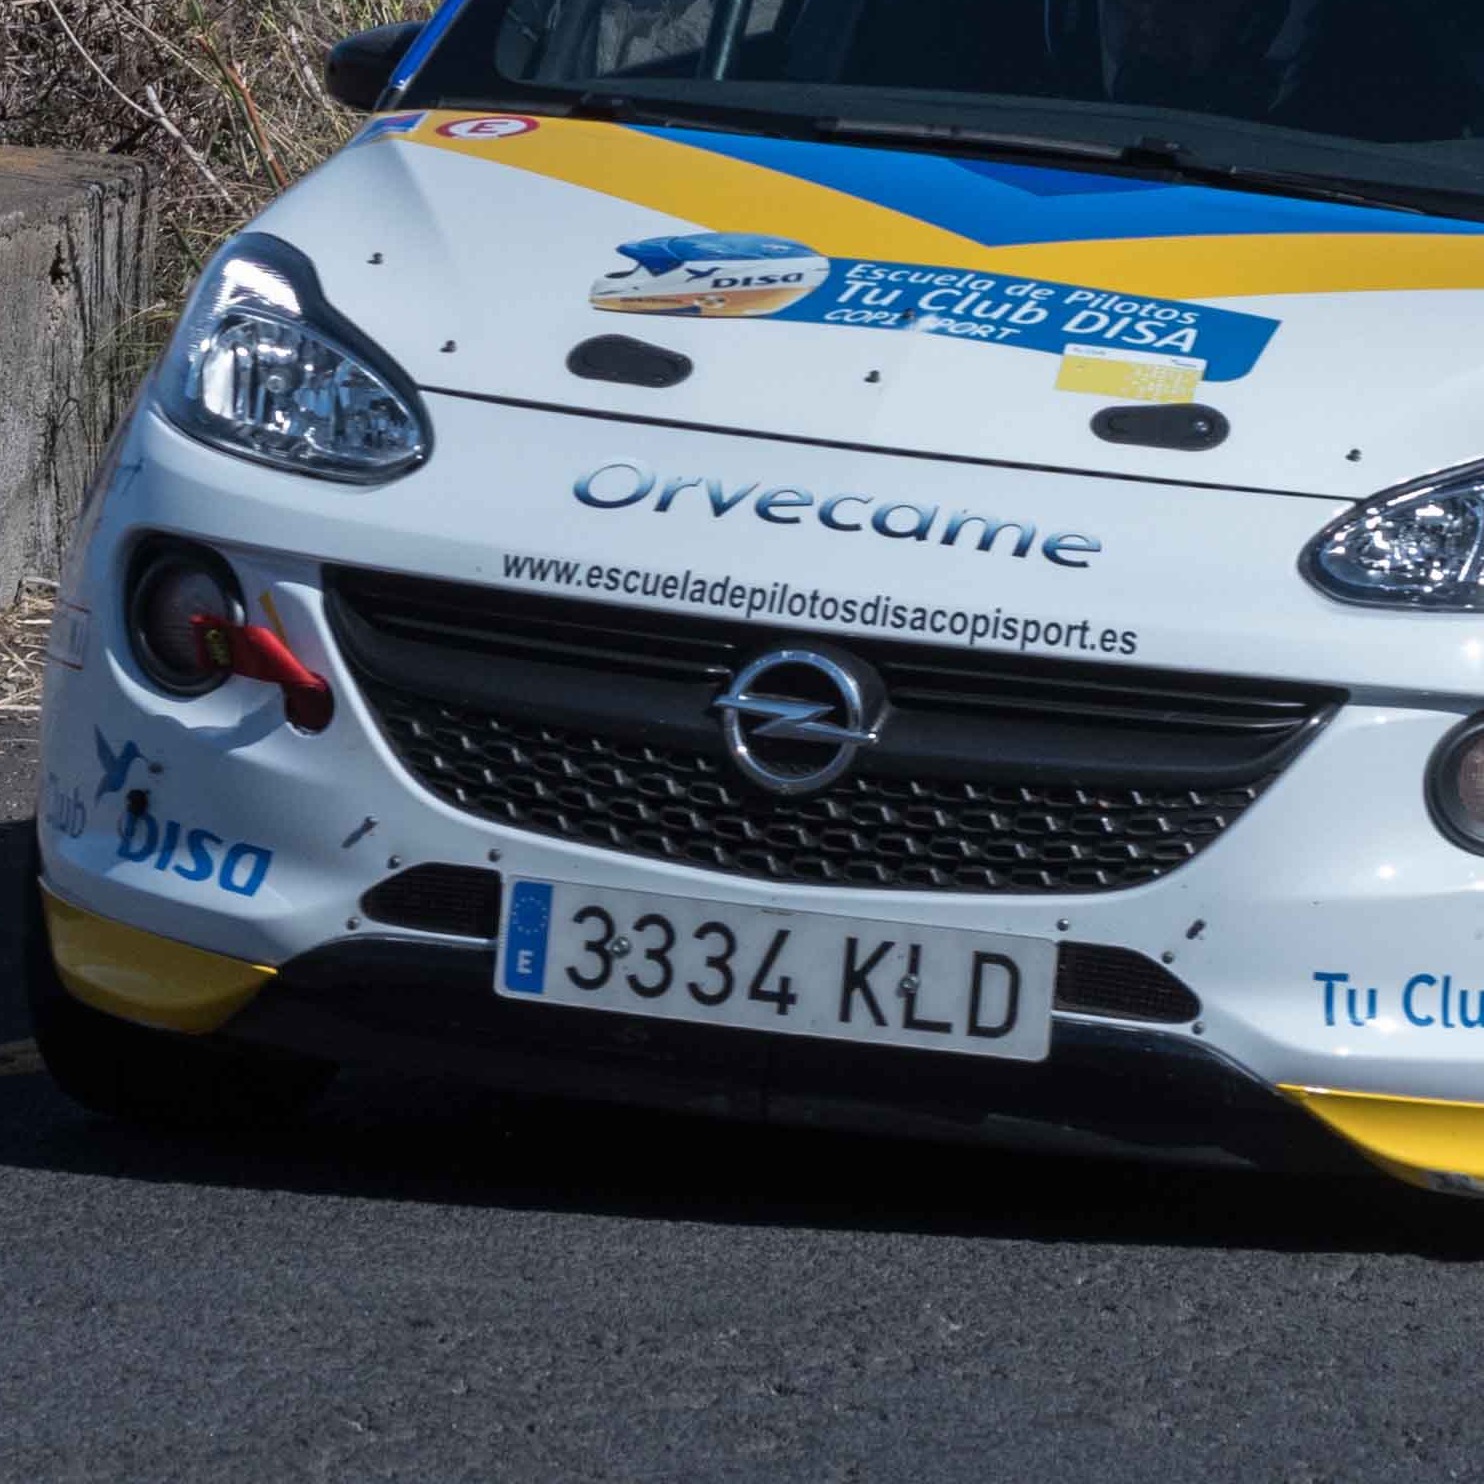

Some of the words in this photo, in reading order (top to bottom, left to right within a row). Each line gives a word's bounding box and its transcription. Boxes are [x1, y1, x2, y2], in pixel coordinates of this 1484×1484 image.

[823, 307, 904, 327] COPI
[835, 279, 904, 306] Tu
[917, 287, 1050, 326] Club
[1062, 309, 1200, 353] DISA
[846, 263, 994, 295] Escuela
[1016, 283, 1057, 301] de
[1064, 289, 1201, 326] Pilotos
[572, 462, 1103, 570] Orvecame
[501, 551, 1138, 657] www.escueladepilotosdisacopisport.es
[517, 949, 533, 974] E
[564, 904, 799, 1017] 3334
[838, 935, 1022, 1040] KLD
[1313, 971, 1378, 1027] Tu
